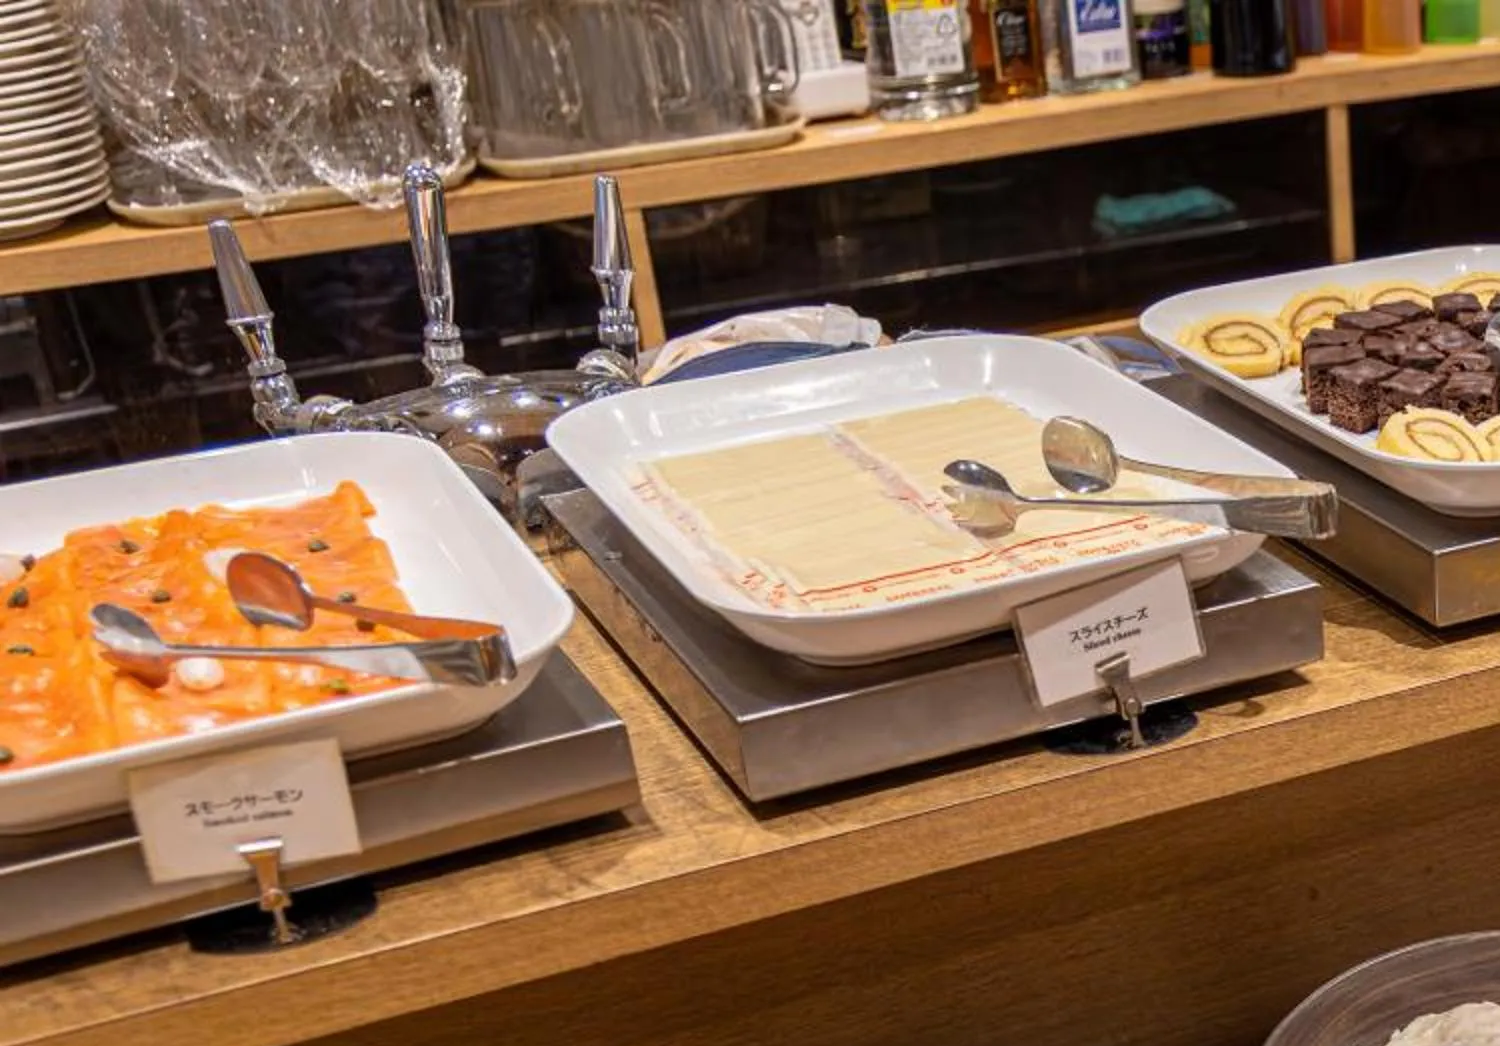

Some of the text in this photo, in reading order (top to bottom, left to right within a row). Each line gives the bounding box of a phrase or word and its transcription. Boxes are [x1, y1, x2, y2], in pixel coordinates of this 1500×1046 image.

[1069, 607, 1149, 643] スライスチーズ
[185, 788, 304, 818] スモークサーモン
